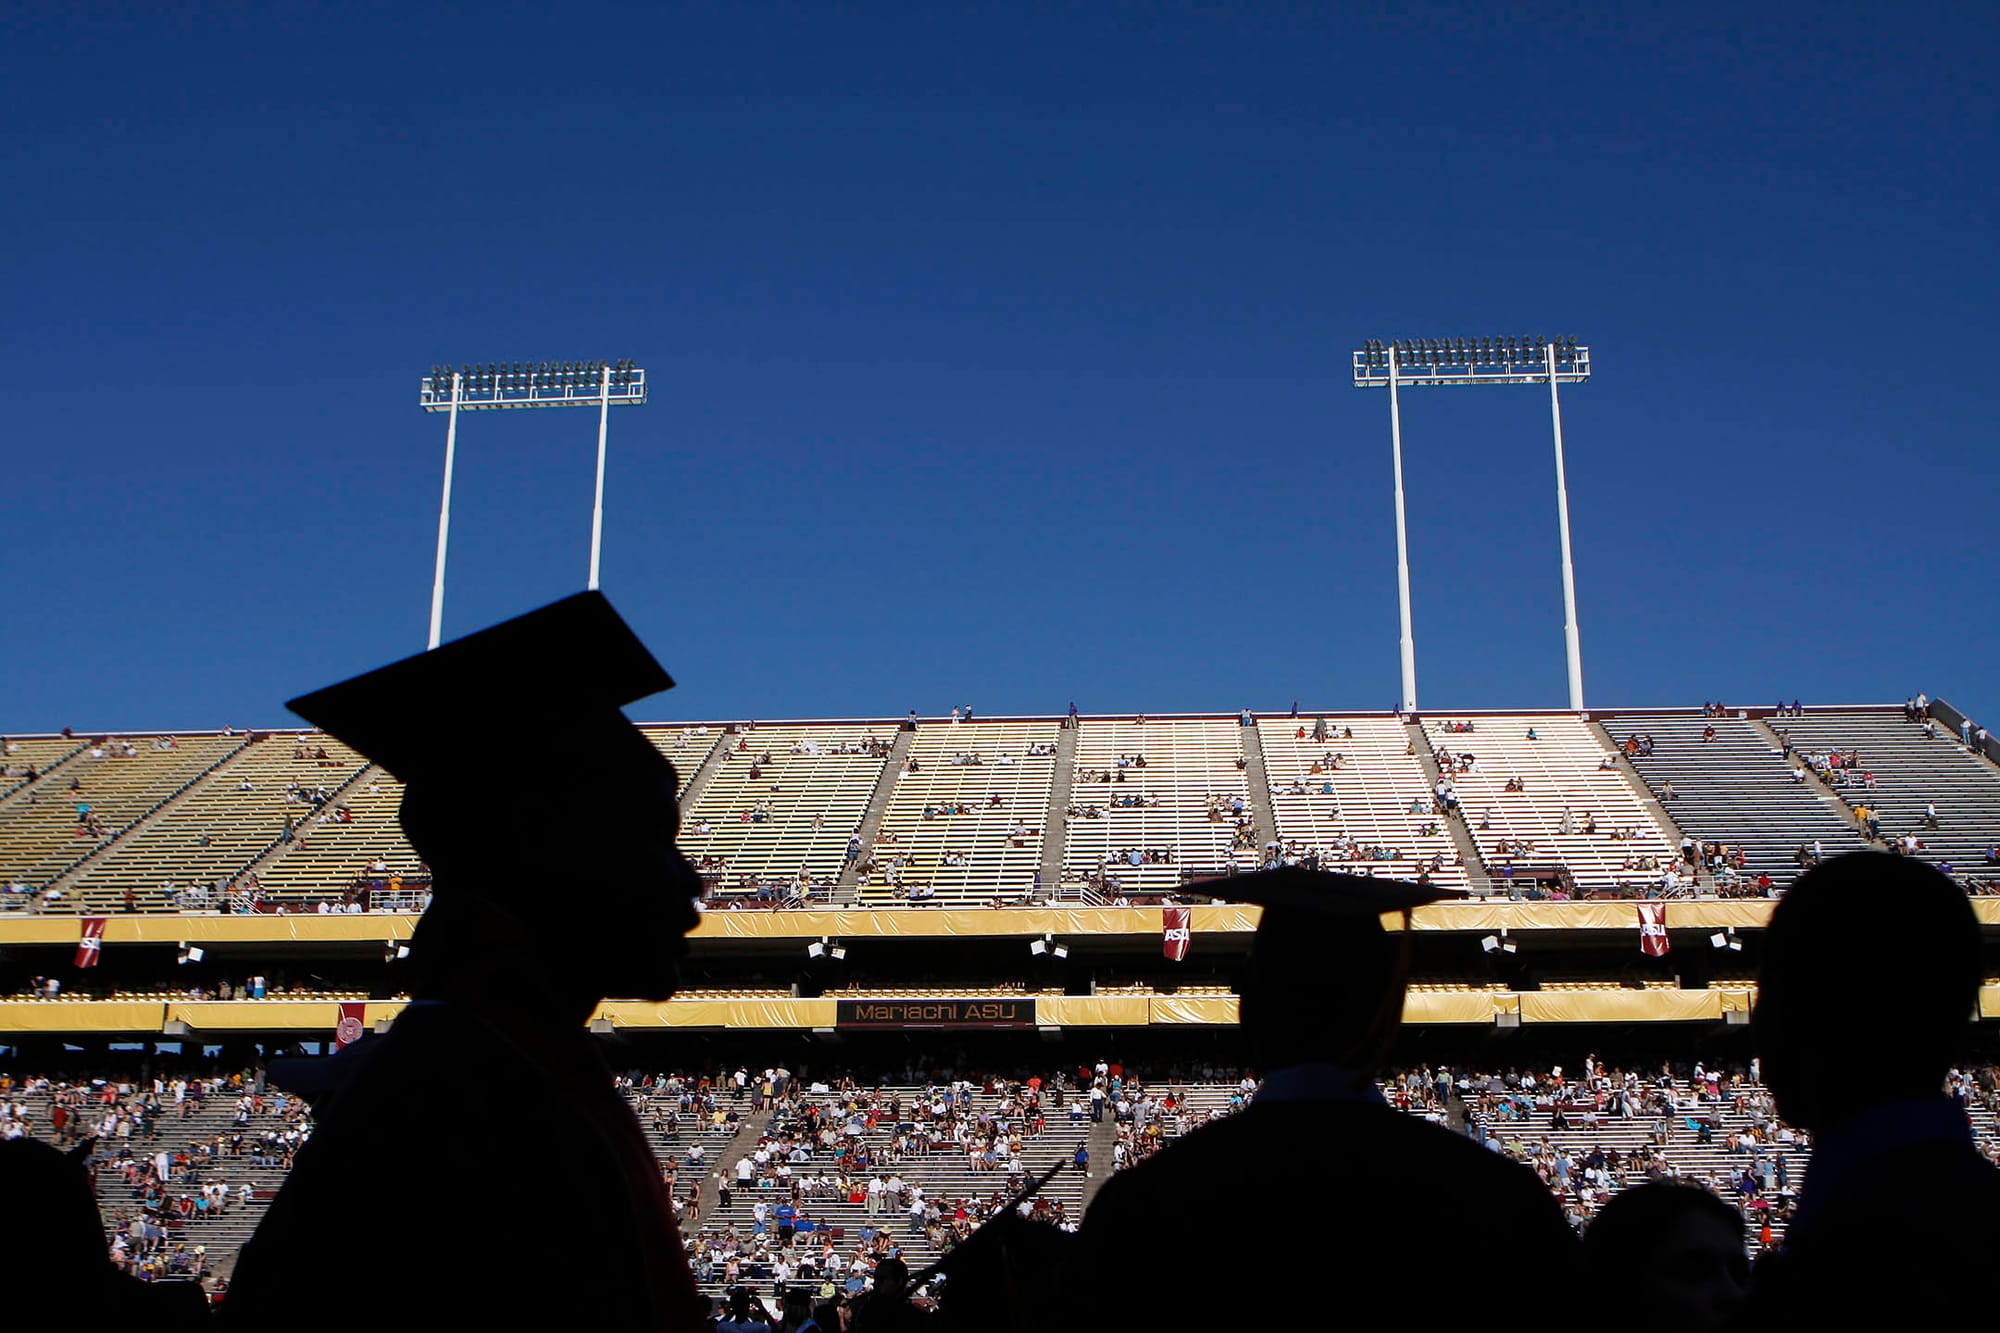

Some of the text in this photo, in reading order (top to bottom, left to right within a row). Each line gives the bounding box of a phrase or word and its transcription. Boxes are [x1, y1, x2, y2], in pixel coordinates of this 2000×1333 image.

[1164, 928, 1190, 942] ASU
[855, 1003, 1016, 1020] Mariachi ASU
